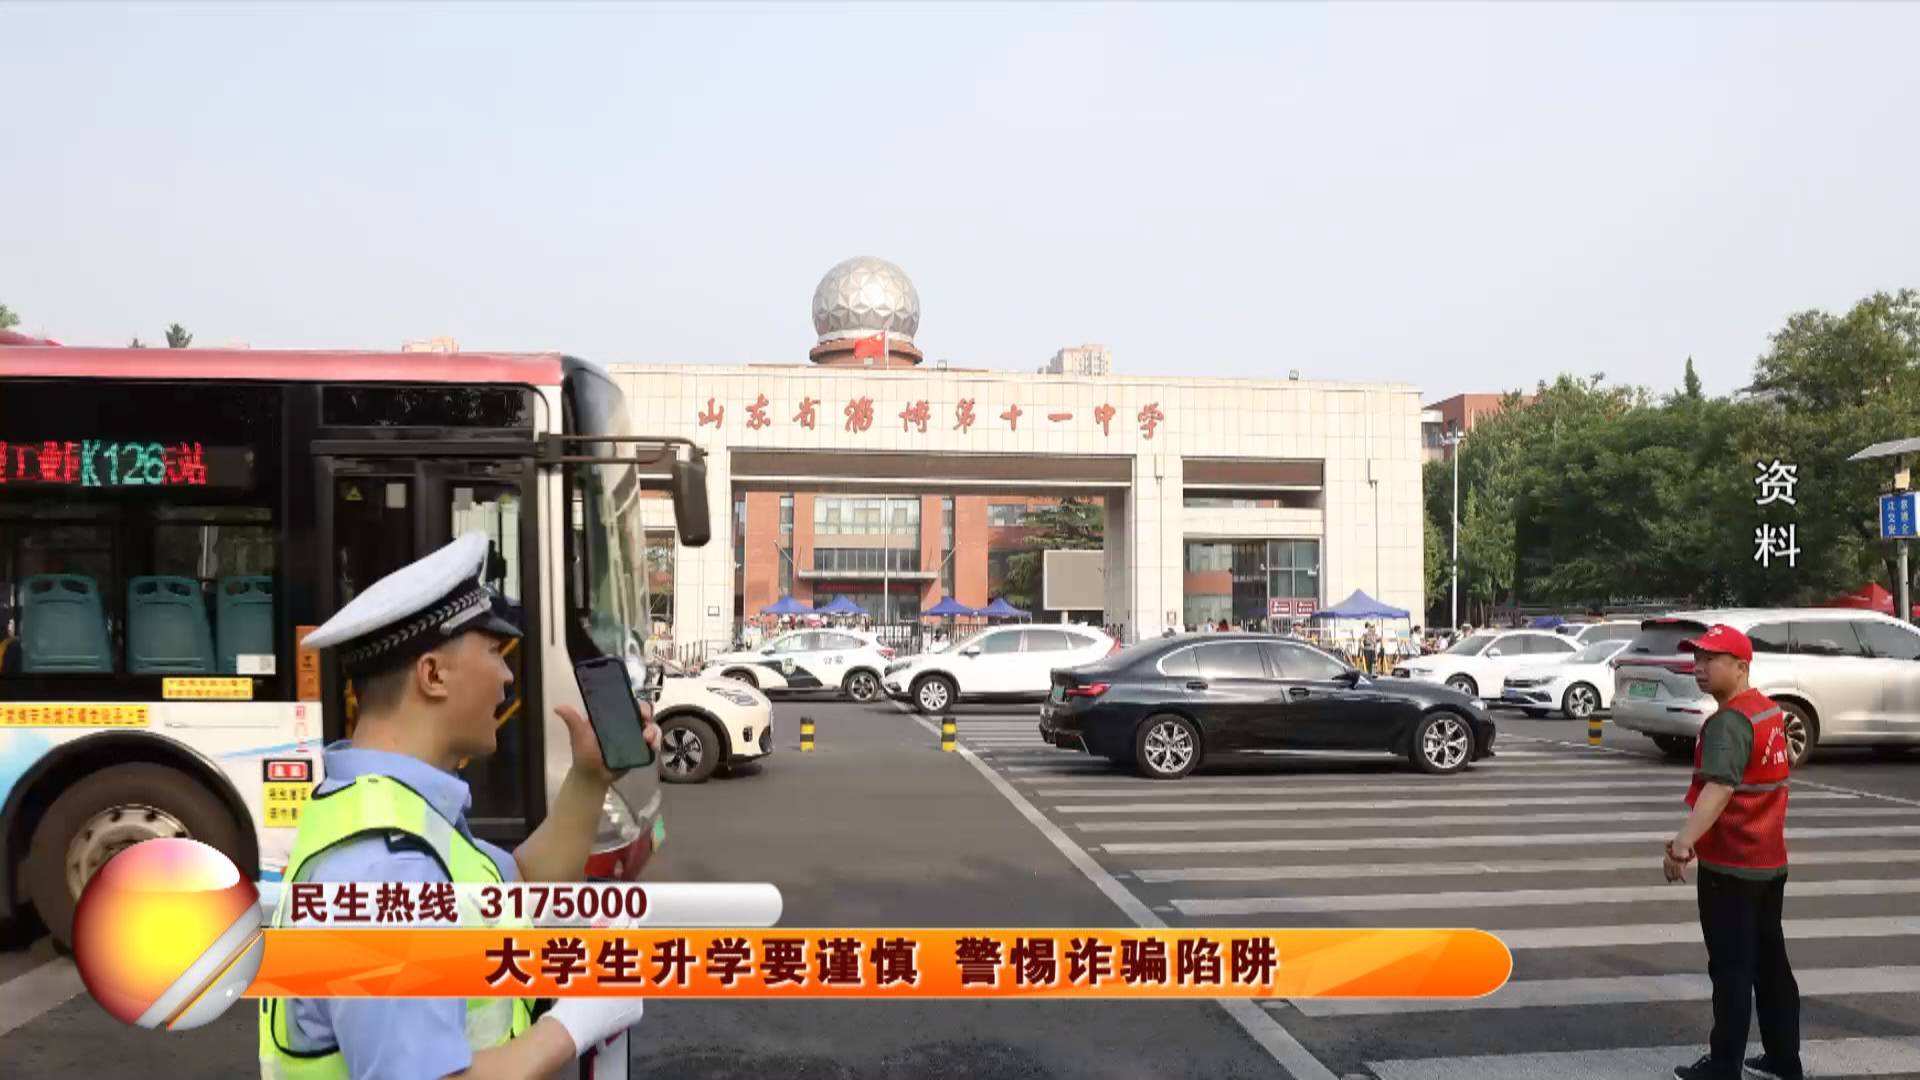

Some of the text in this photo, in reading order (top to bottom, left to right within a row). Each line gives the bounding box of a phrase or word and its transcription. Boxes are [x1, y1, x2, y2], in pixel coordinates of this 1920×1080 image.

[697, 395, 1165, 441] 山东省淄博第十一中学
[81, 440, 164, 487] K126
